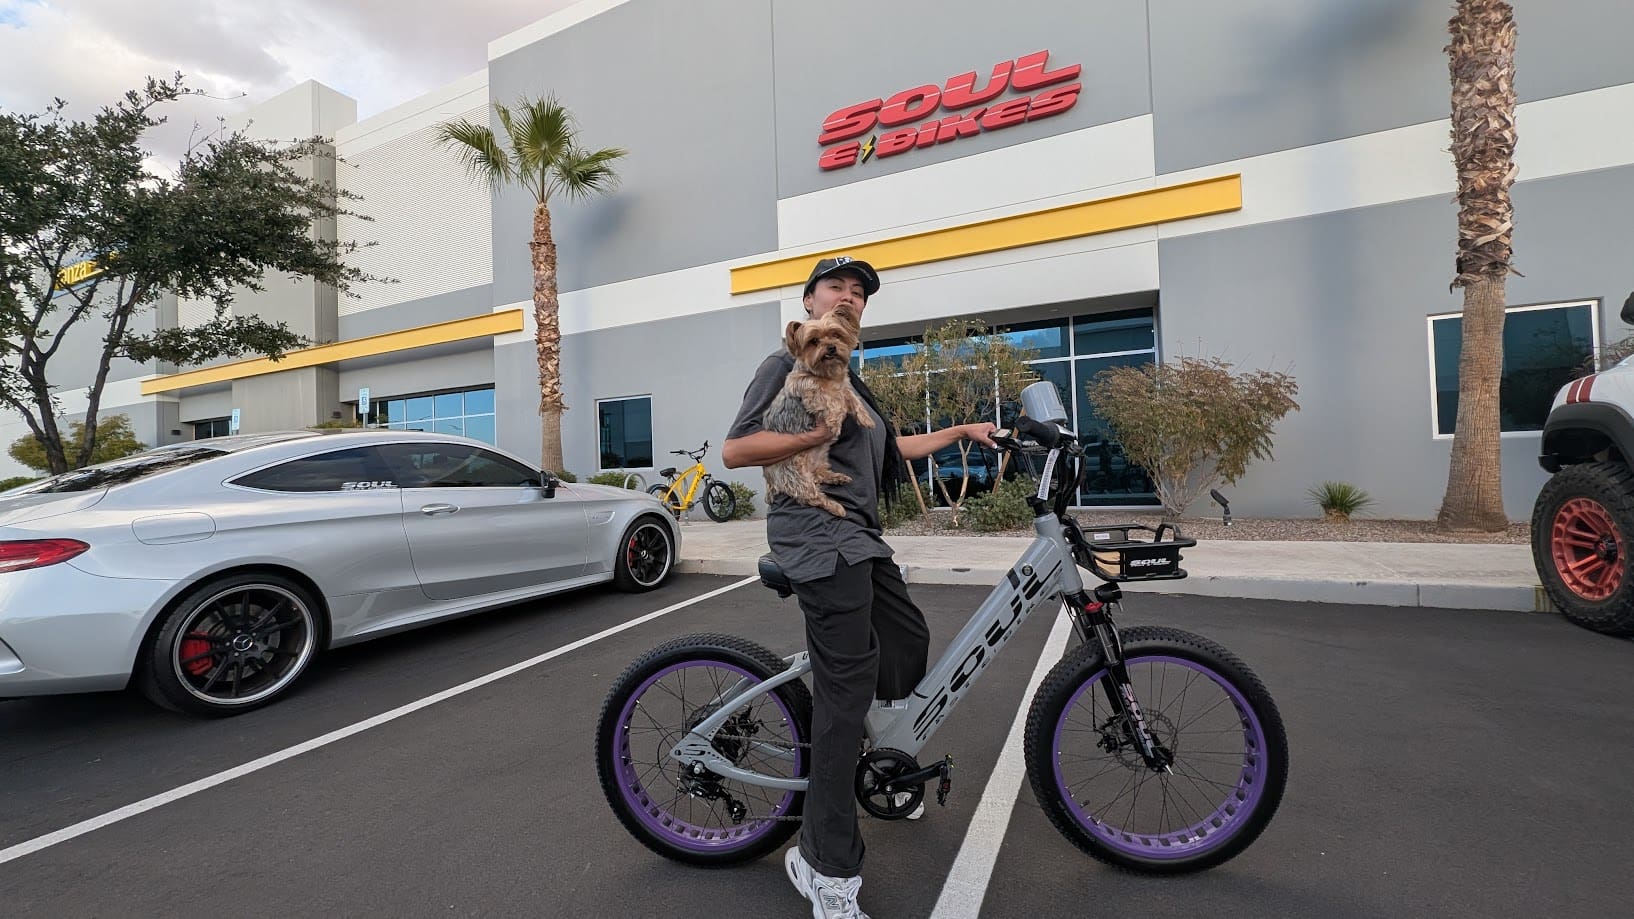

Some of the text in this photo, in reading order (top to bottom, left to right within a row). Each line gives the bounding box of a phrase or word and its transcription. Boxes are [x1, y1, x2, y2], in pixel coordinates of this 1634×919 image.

[818, 50, 1081, 146] SOUL
[876, 82, 1081, 158] BIKES
[913, 560, 1062, 741] SOUL
